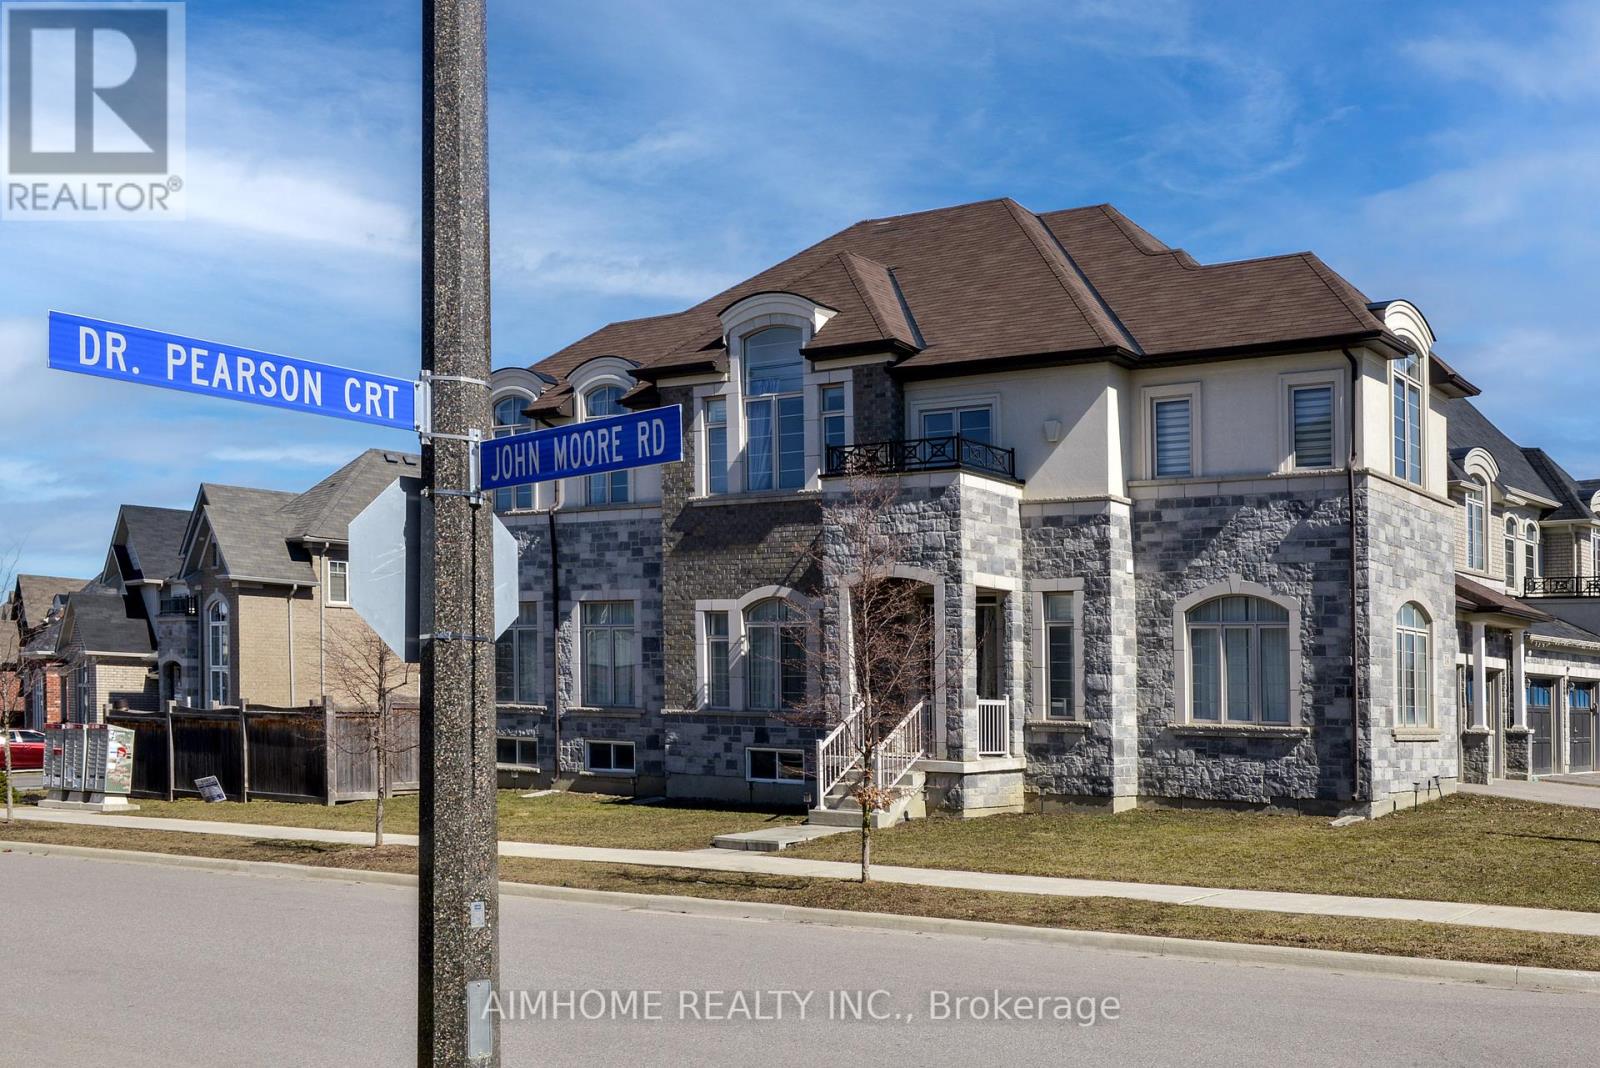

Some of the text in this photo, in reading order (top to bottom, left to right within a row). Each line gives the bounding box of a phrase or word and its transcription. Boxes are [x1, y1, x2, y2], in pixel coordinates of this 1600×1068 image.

[79, 326, 399, 419] DR. PEARSON CRT
[492, 418, 666, 481] JOHN MOORE RD
